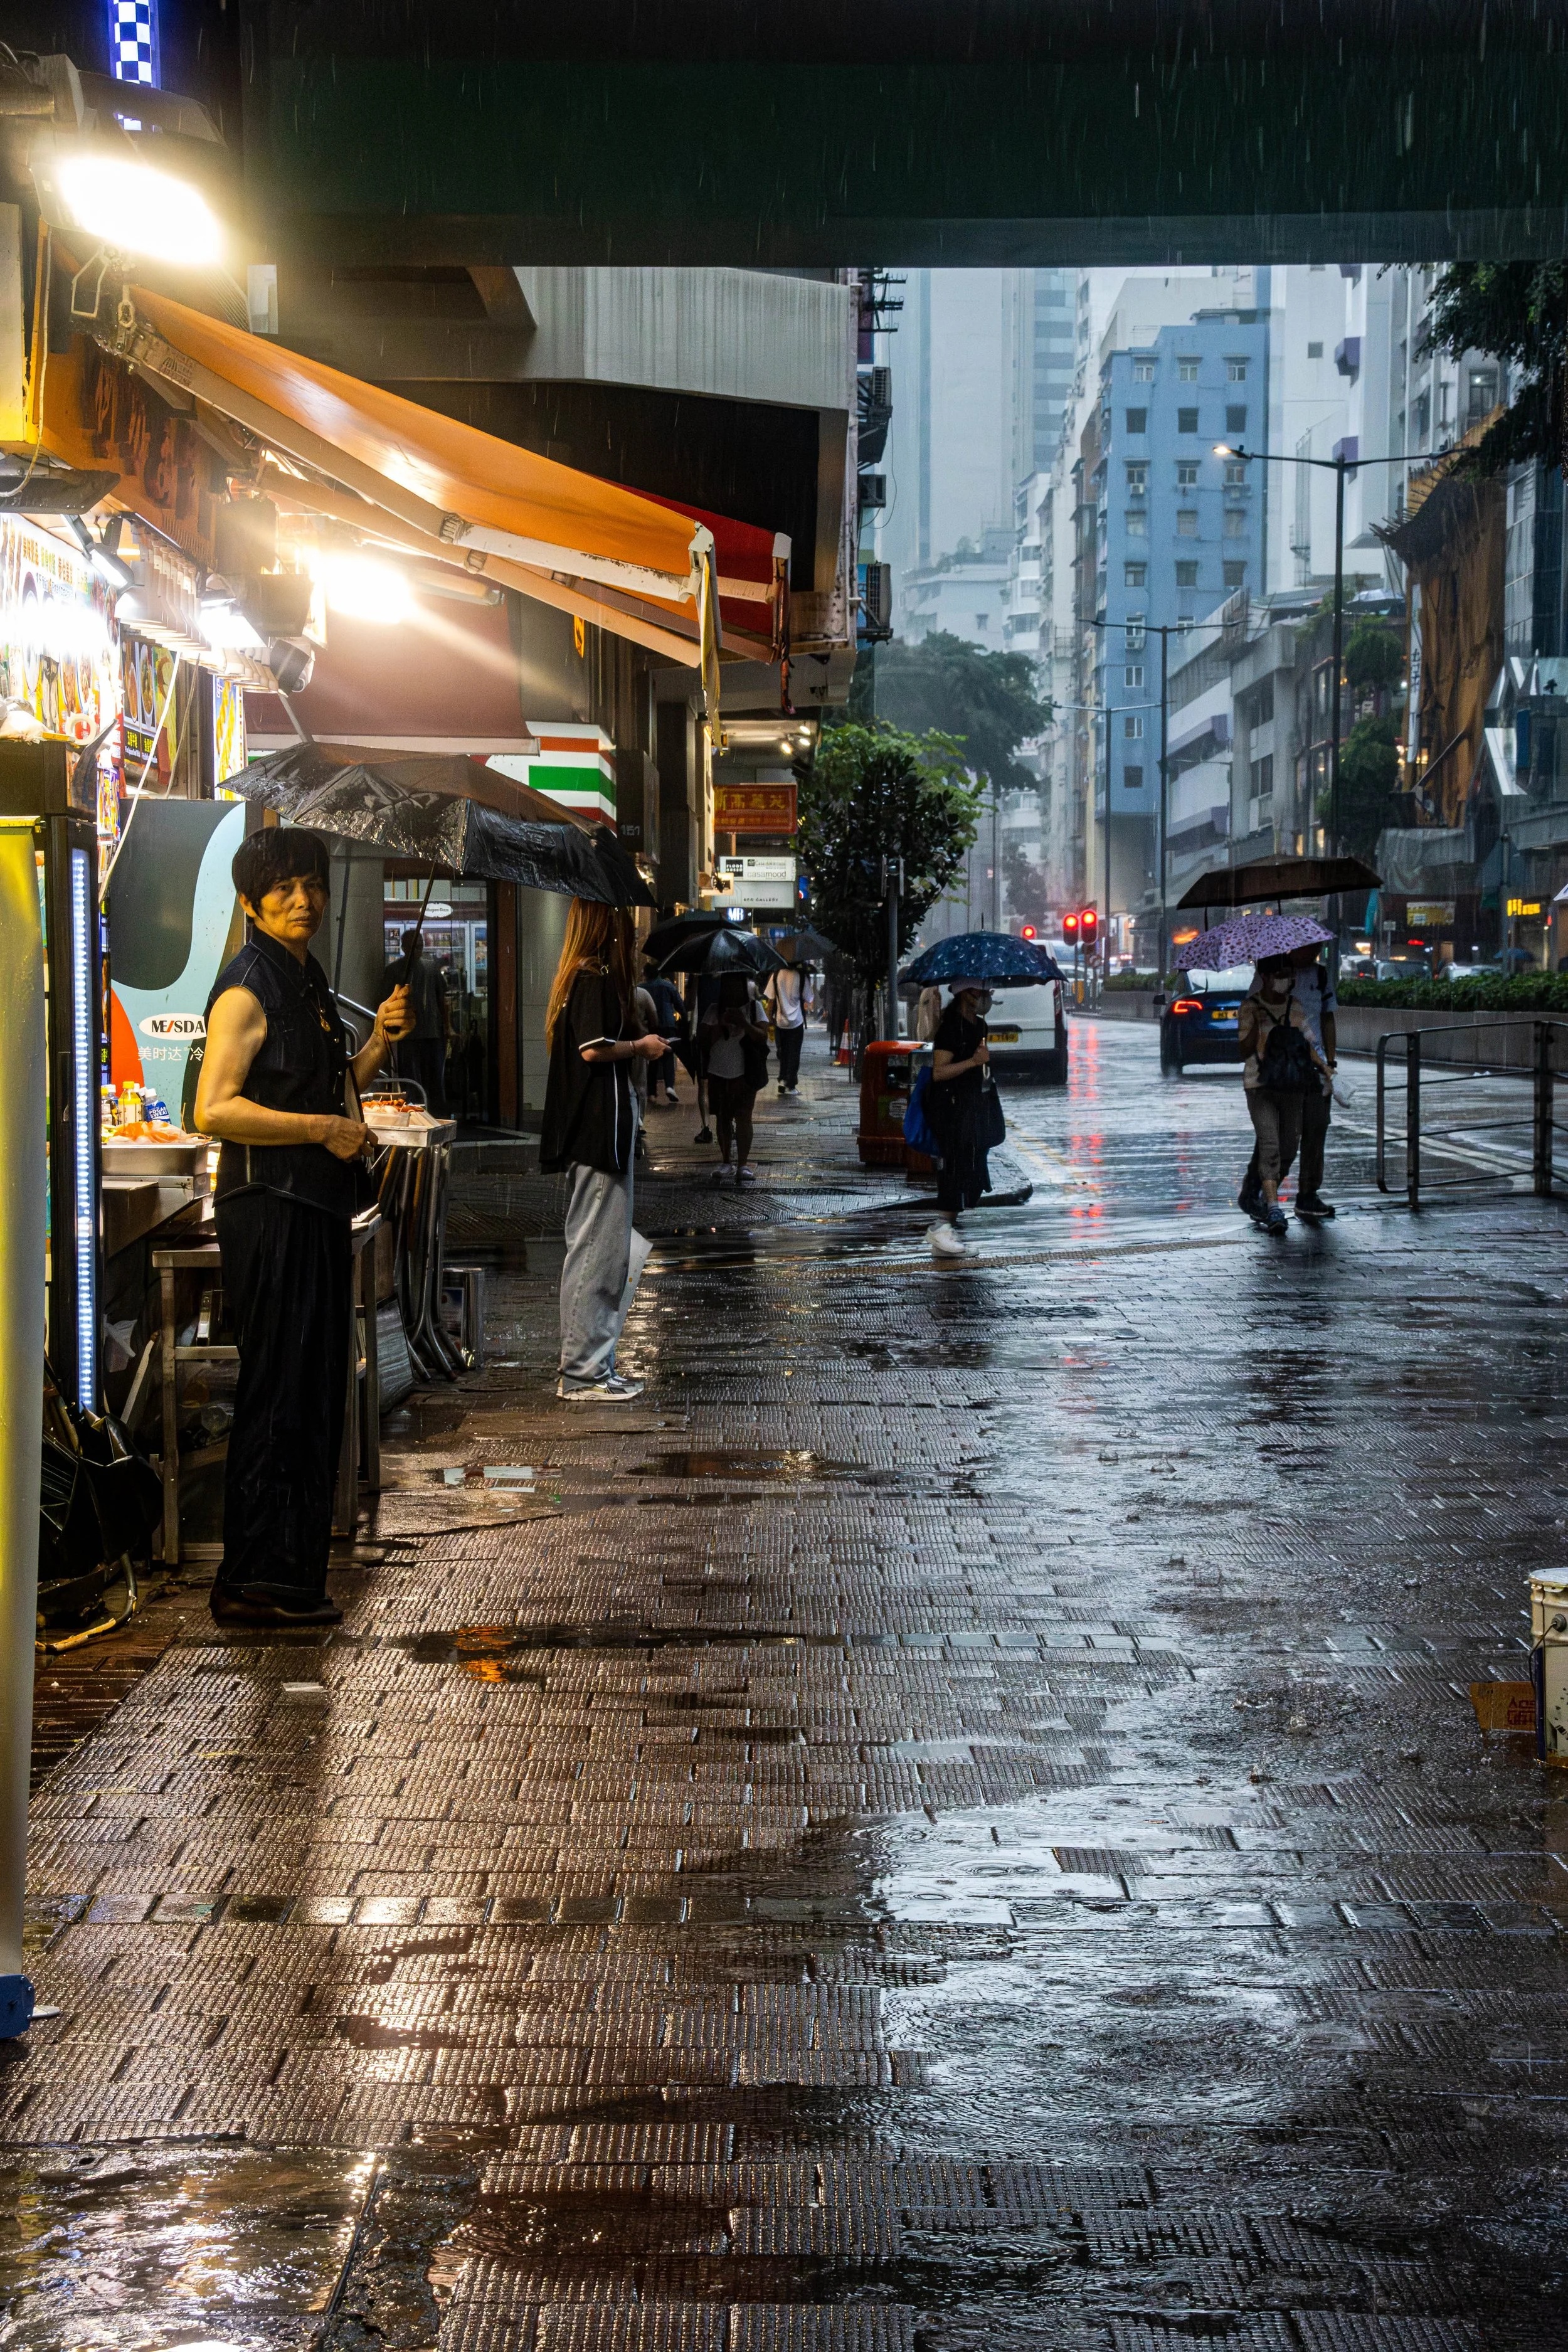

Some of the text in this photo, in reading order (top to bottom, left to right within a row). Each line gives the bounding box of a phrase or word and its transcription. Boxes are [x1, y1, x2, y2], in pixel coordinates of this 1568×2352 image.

[152, 1020, 204, 1033] MEISDA
[138, 1046, 183, 1061] 美时达
